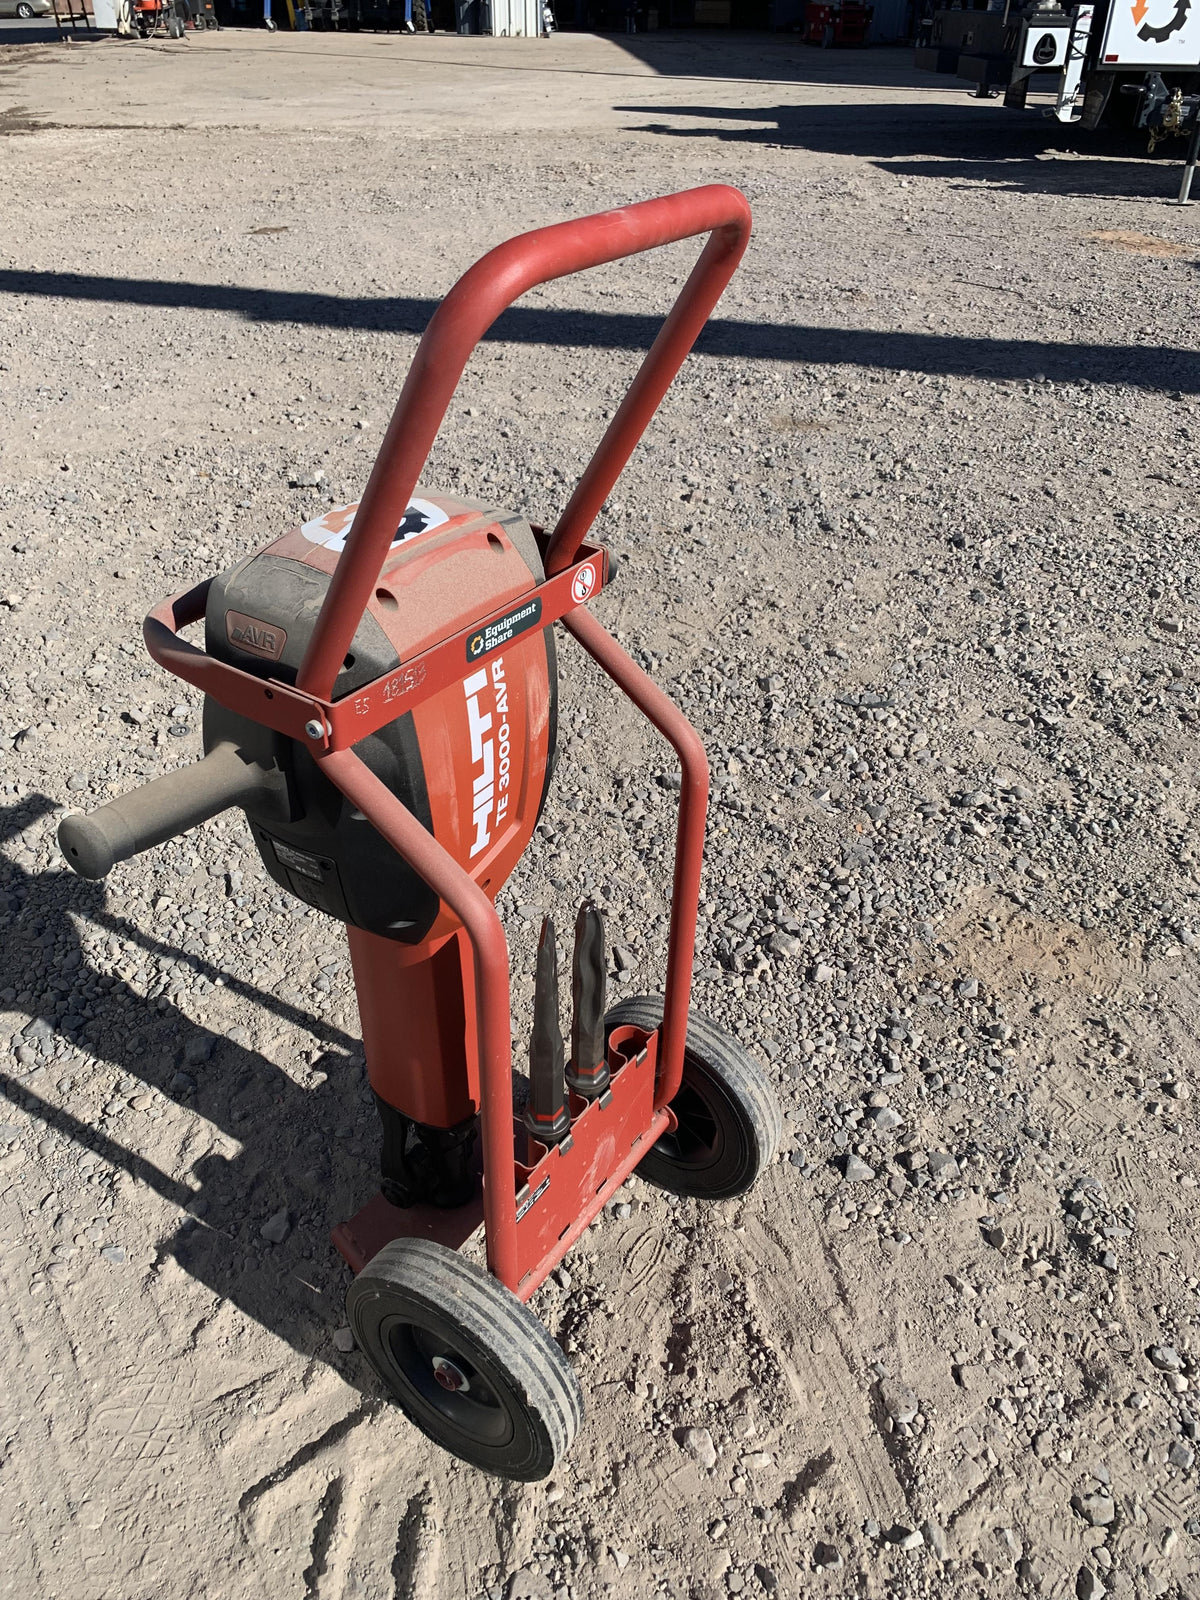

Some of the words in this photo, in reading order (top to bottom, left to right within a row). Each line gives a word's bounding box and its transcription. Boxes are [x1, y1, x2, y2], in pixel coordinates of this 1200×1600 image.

[242, 624, 276, 654] AVR
[484, 602, 537, 640] Equipment
[484, 628, 514, 651] Share
[491, 656, 511, 792] 3000-AVR
[463, 667, 494, 859] HILTI
[495, 793, 509, 828] TE
